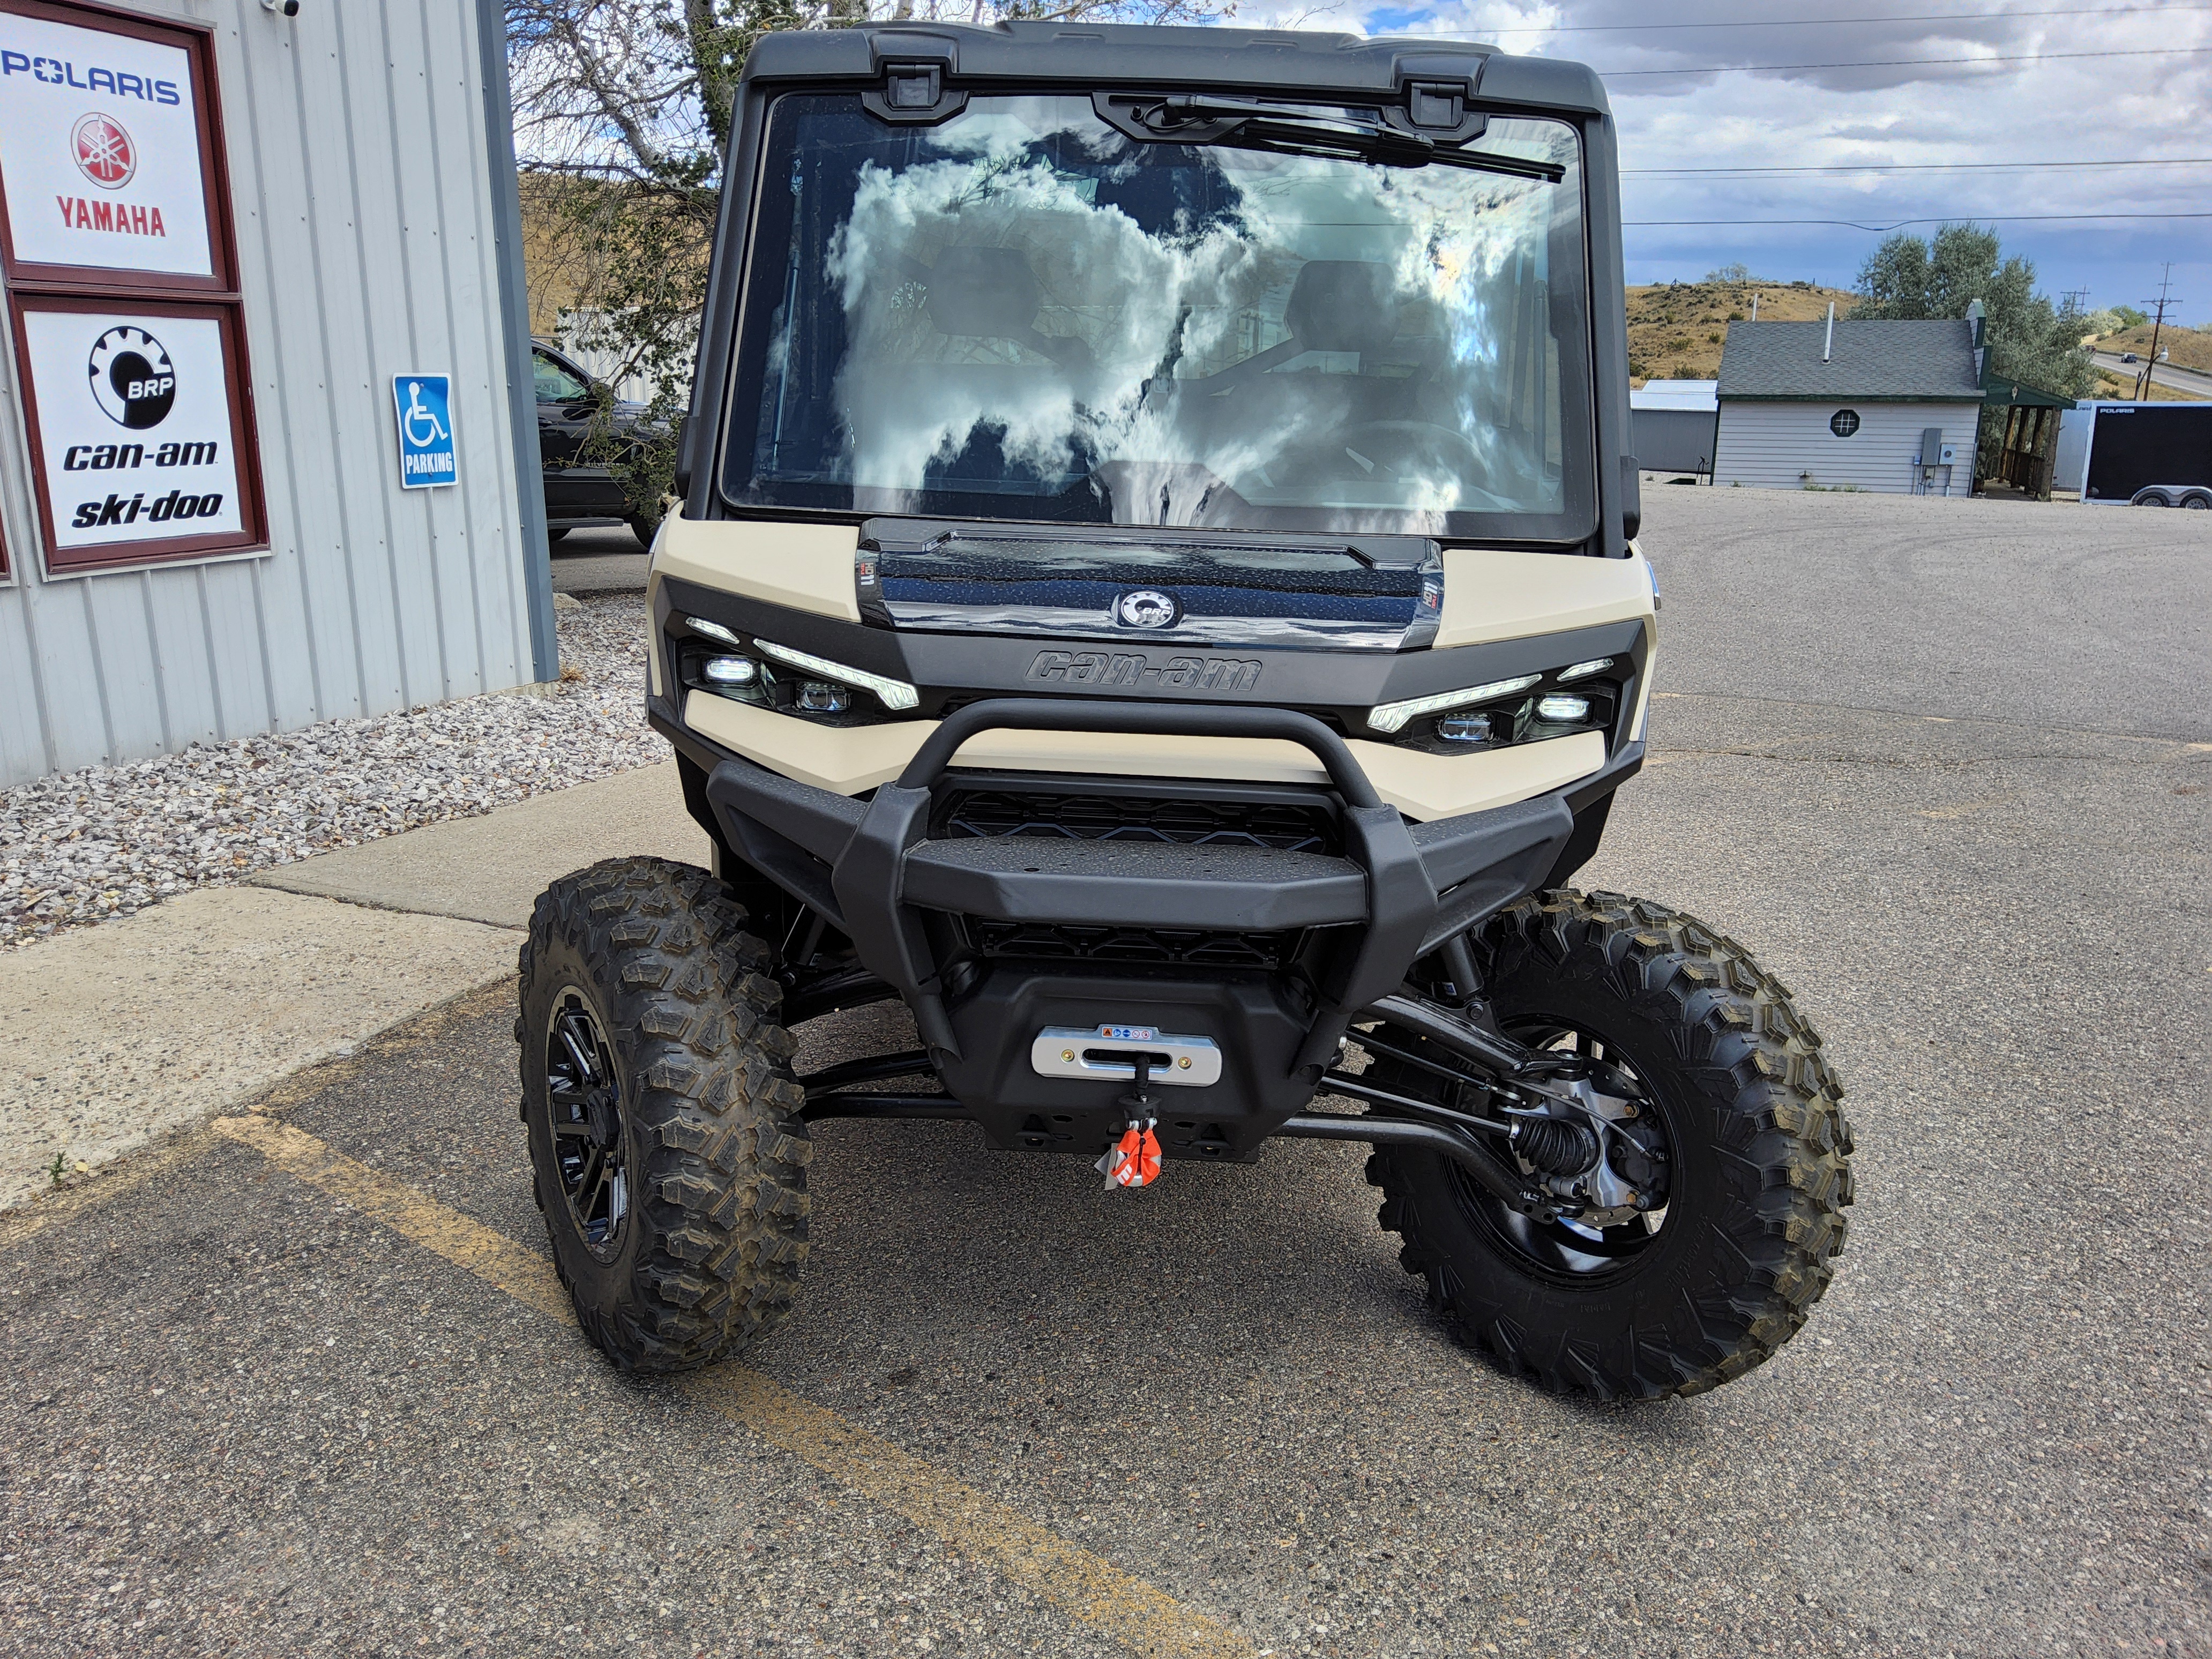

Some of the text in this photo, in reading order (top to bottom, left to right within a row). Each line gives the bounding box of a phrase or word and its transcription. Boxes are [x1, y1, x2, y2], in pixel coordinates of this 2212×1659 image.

[1, 50, 181, 106] POLARIS
[56, 196, 166, 237] YAMAHA
[128, 377, 173, 400] BRP
[63, 440, 218, 471] can-am
[406, 452, 453, 474] PARKING
[71, 490, 223, 528] ski-doo
[1142, 607, 1171, 616] BRP
[1025, 650, 1263, 691] can-am
